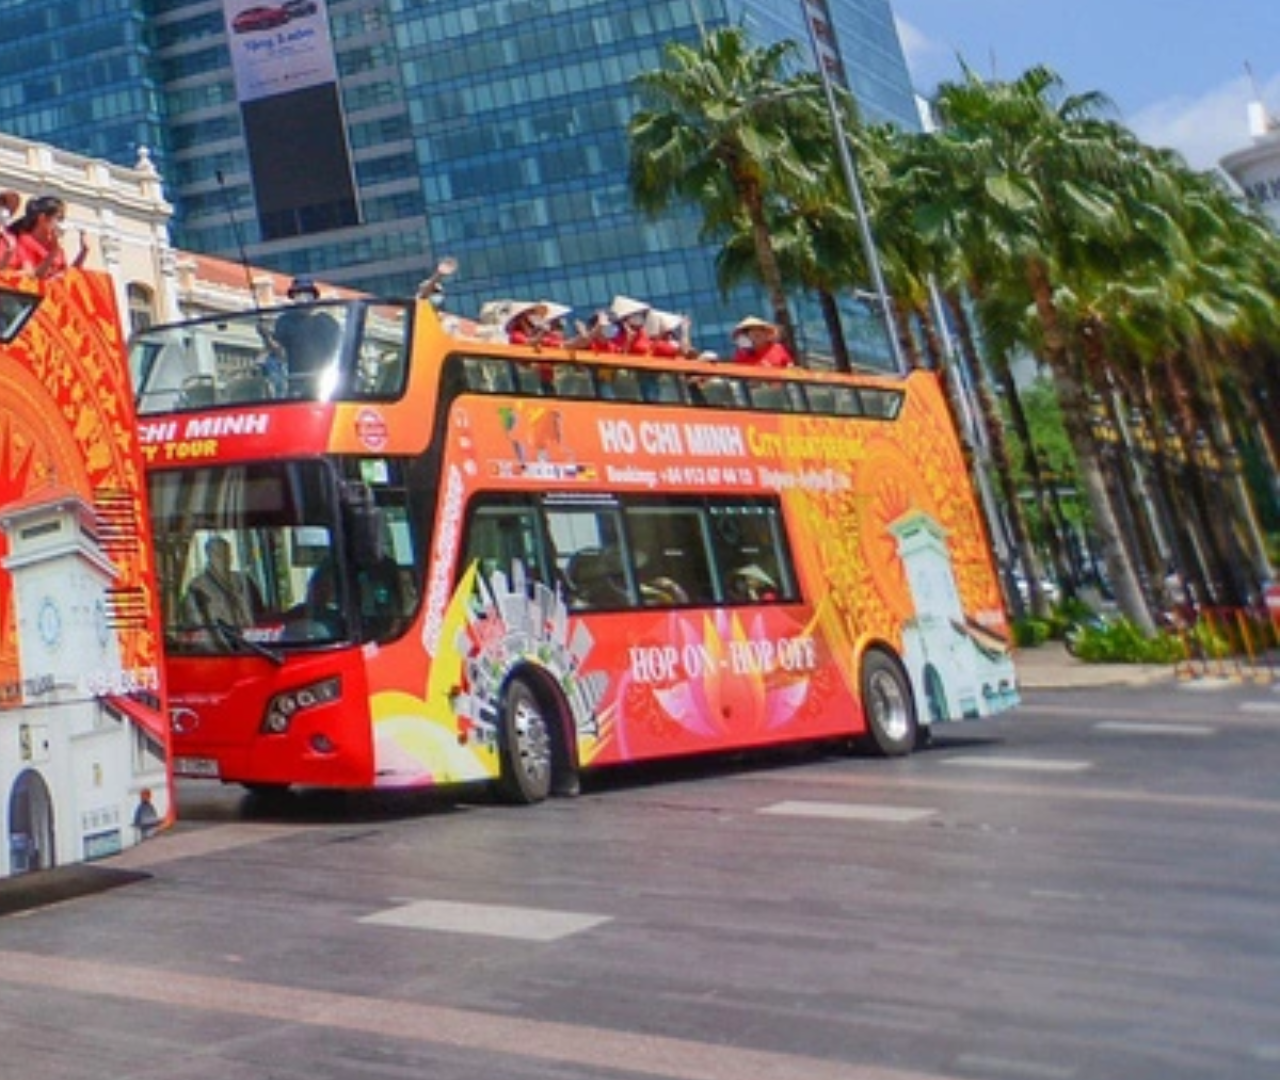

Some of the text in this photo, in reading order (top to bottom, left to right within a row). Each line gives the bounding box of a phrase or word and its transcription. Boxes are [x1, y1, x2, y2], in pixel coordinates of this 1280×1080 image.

[185, 413, 270, 440] MINH
[597, 418, 637, 455] HO
[640, 419, 684, 456] CHI
[683, 421, 746, 457] MINH
[164, 438, 219, 461] TOUR
[628, 644, 678, 683] HOP
[729, 639, 774, 675] HOP
